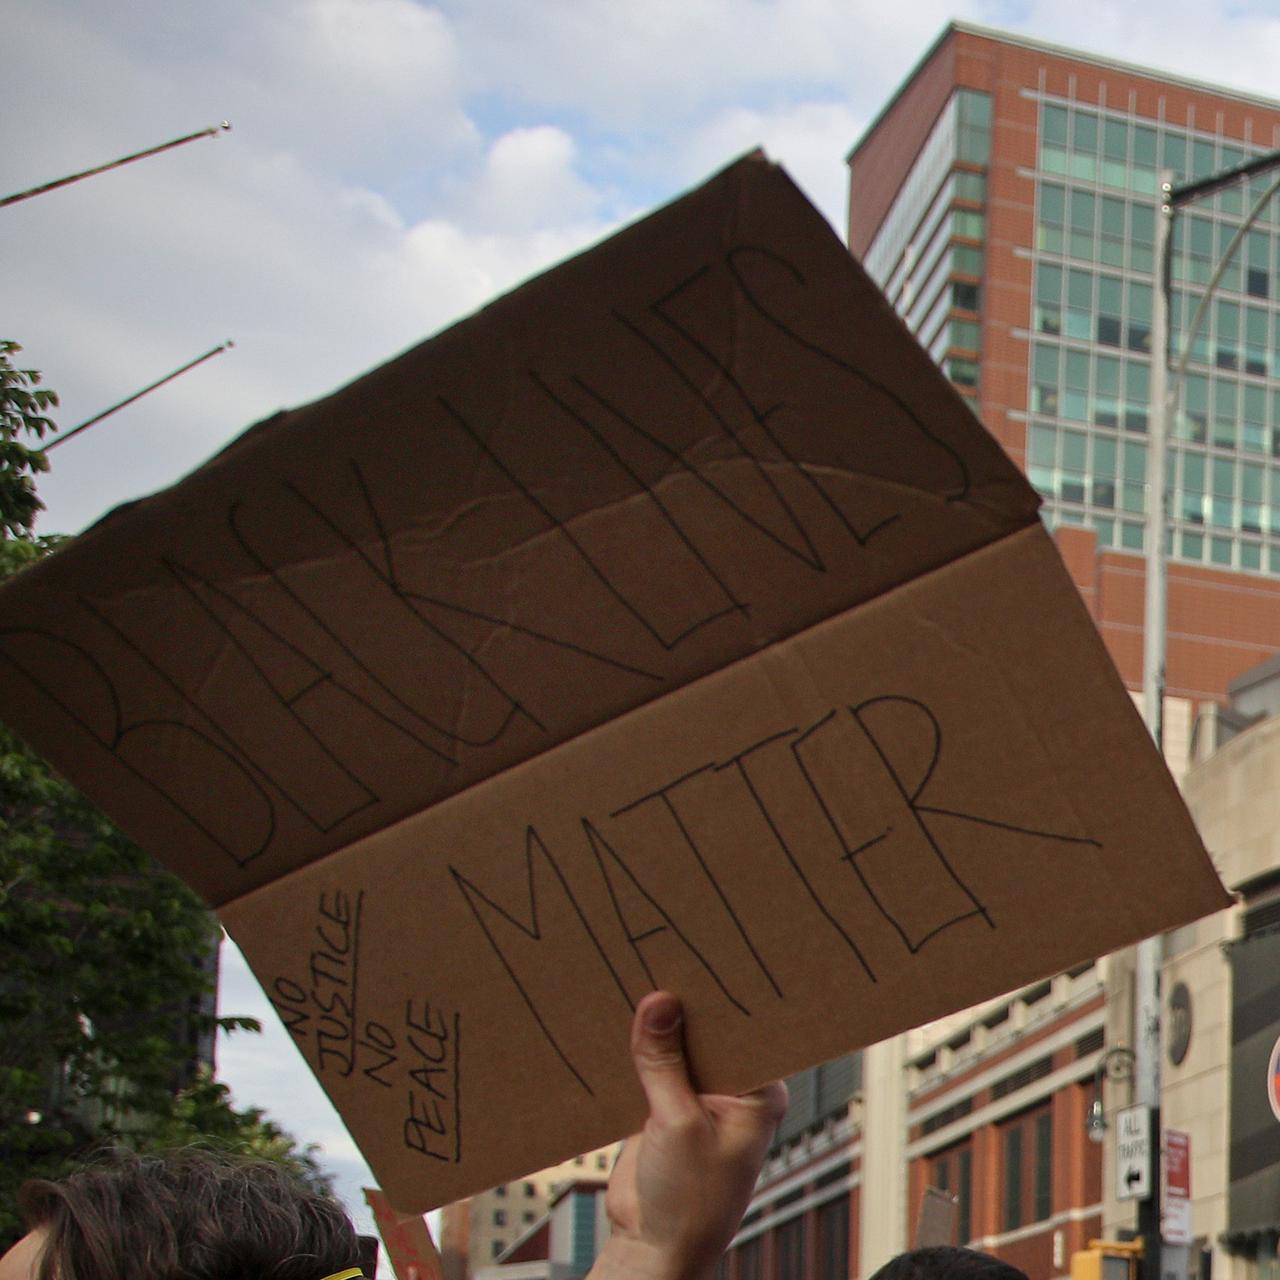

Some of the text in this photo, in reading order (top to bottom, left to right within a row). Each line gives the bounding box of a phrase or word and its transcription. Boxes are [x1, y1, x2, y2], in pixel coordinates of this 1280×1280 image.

[438, 246, 971, 650] LIVES
[310, 887, 353, 1078] JUSTICE
[449, 695, 1102, 1097] MATTER
[270, 976, 310, 1037] NO
[358, 1021, 398, 1088] NO
[404, 999, 449, 1162] PEACE
